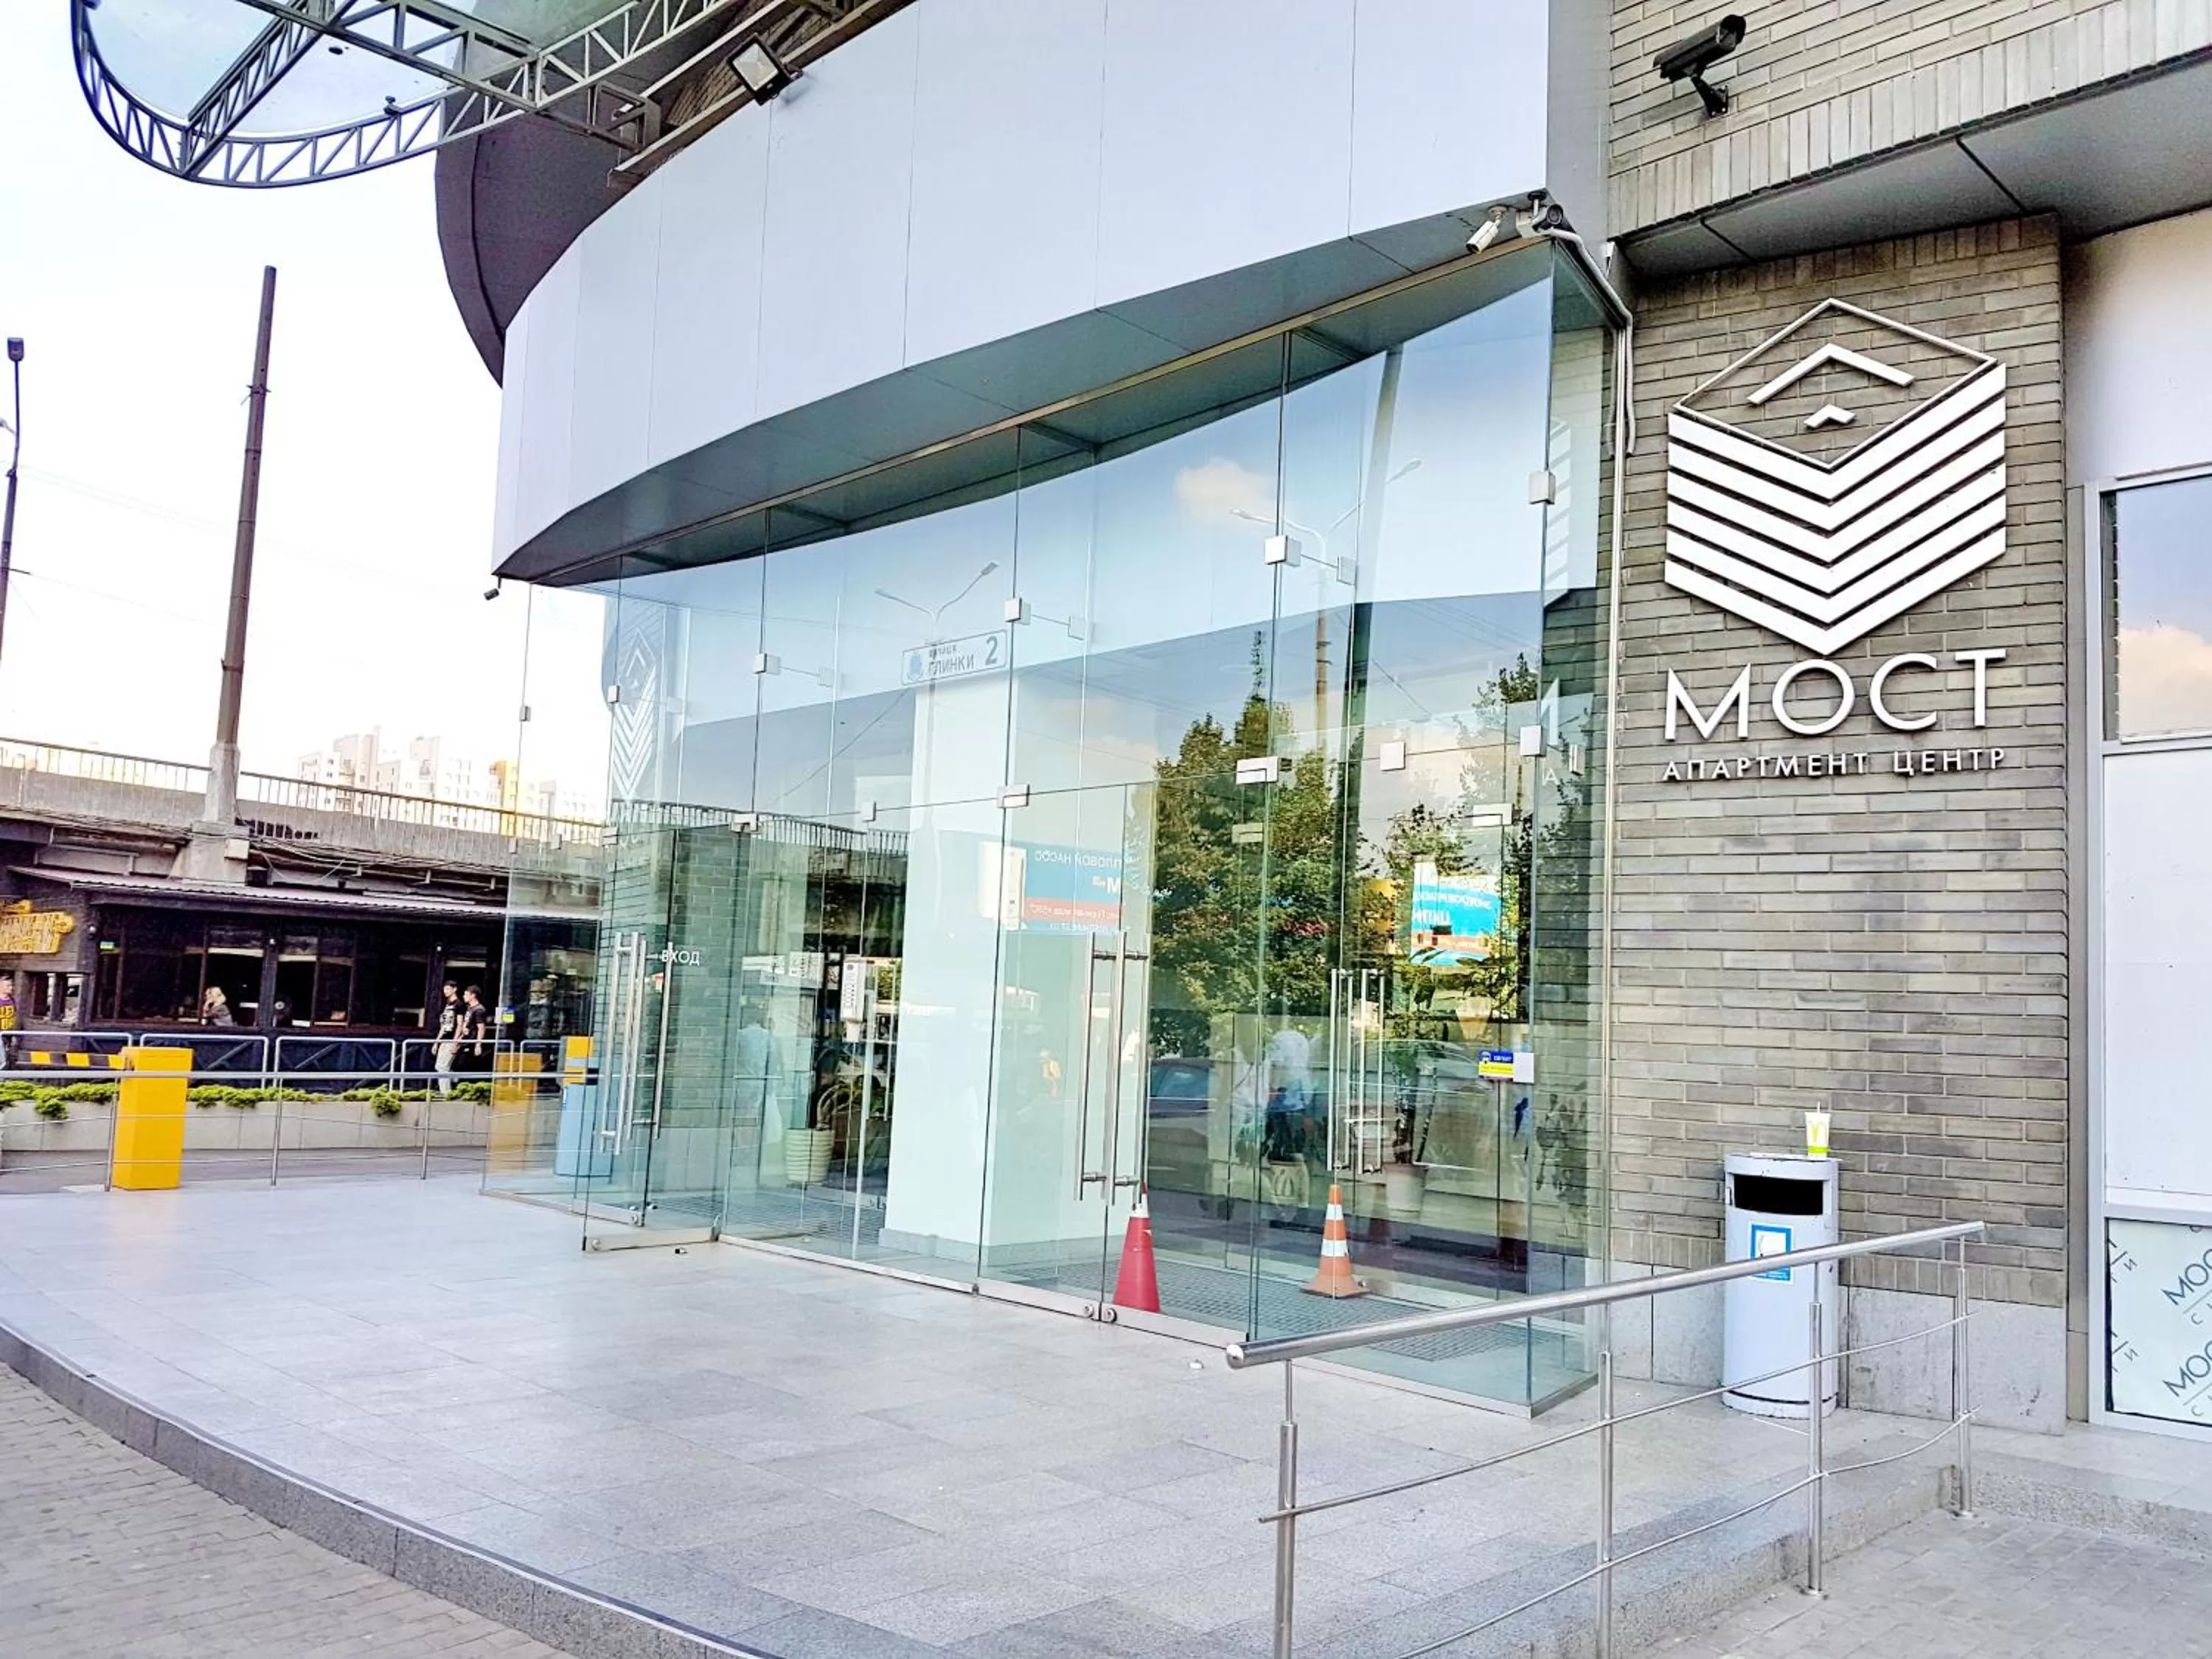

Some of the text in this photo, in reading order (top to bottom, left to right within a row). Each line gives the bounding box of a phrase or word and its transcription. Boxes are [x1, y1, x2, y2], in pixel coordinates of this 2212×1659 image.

[928, 636, 998, 676] ГЛИНКИ 2
[1664, 649, 2007, 741] МОСТ
[1663, 748, 2006, 782] АПАРТМЕНТ ЦЕНТР
[662, 949, 700, 967] ВХОД
